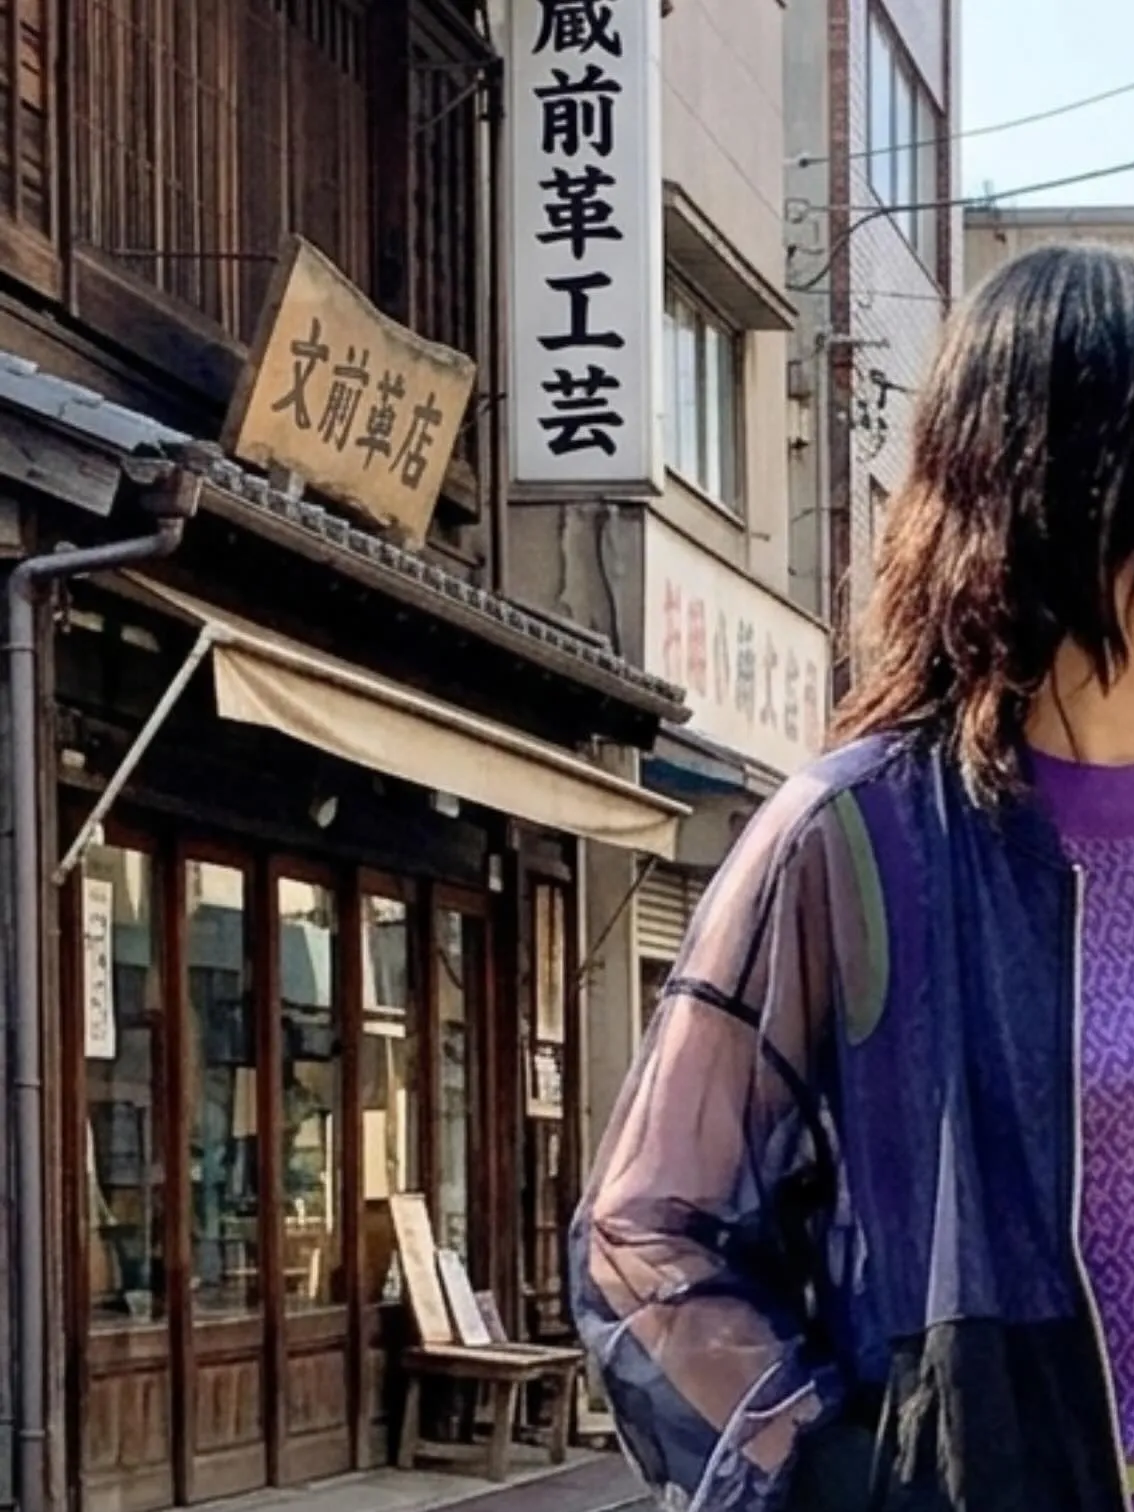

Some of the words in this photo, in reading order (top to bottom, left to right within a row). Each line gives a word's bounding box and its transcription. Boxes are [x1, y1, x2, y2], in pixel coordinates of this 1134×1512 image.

[532, 0, 626, 457] 蔵前革工芸
